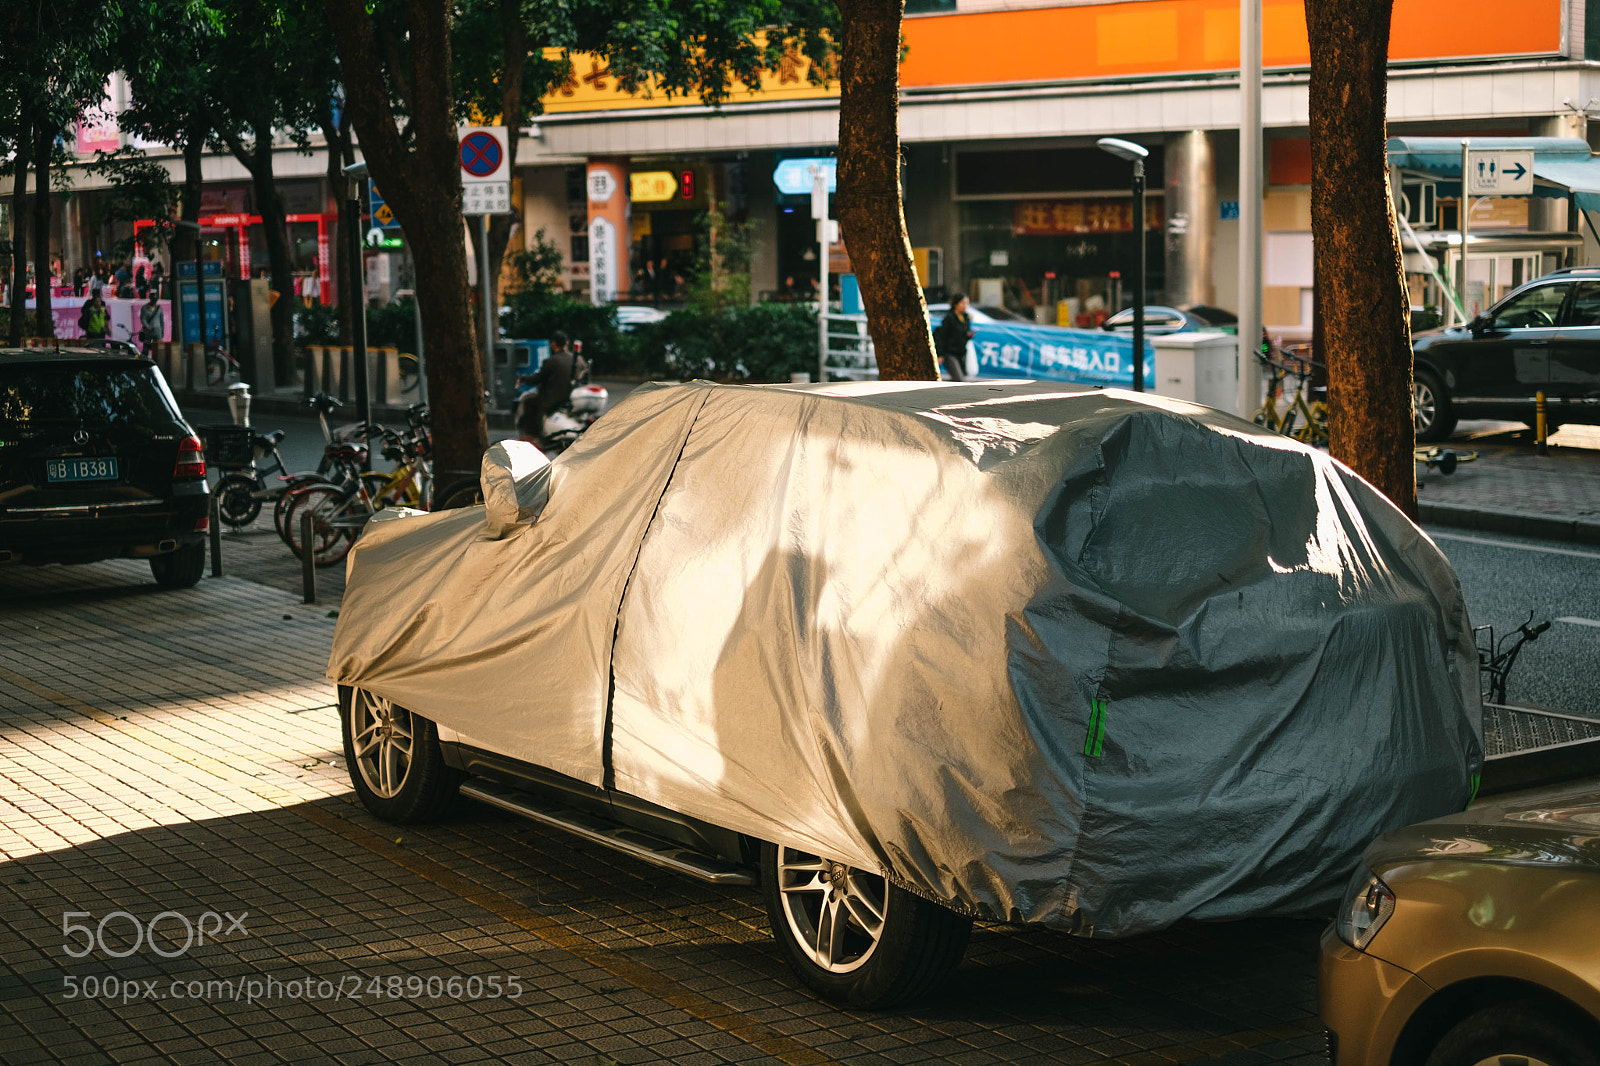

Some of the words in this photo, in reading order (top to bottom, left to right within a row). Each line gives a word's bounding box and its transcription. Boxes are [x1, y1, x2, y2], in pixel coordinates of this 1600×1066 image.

[1040, 344, 1120, 373] 停车场入口
